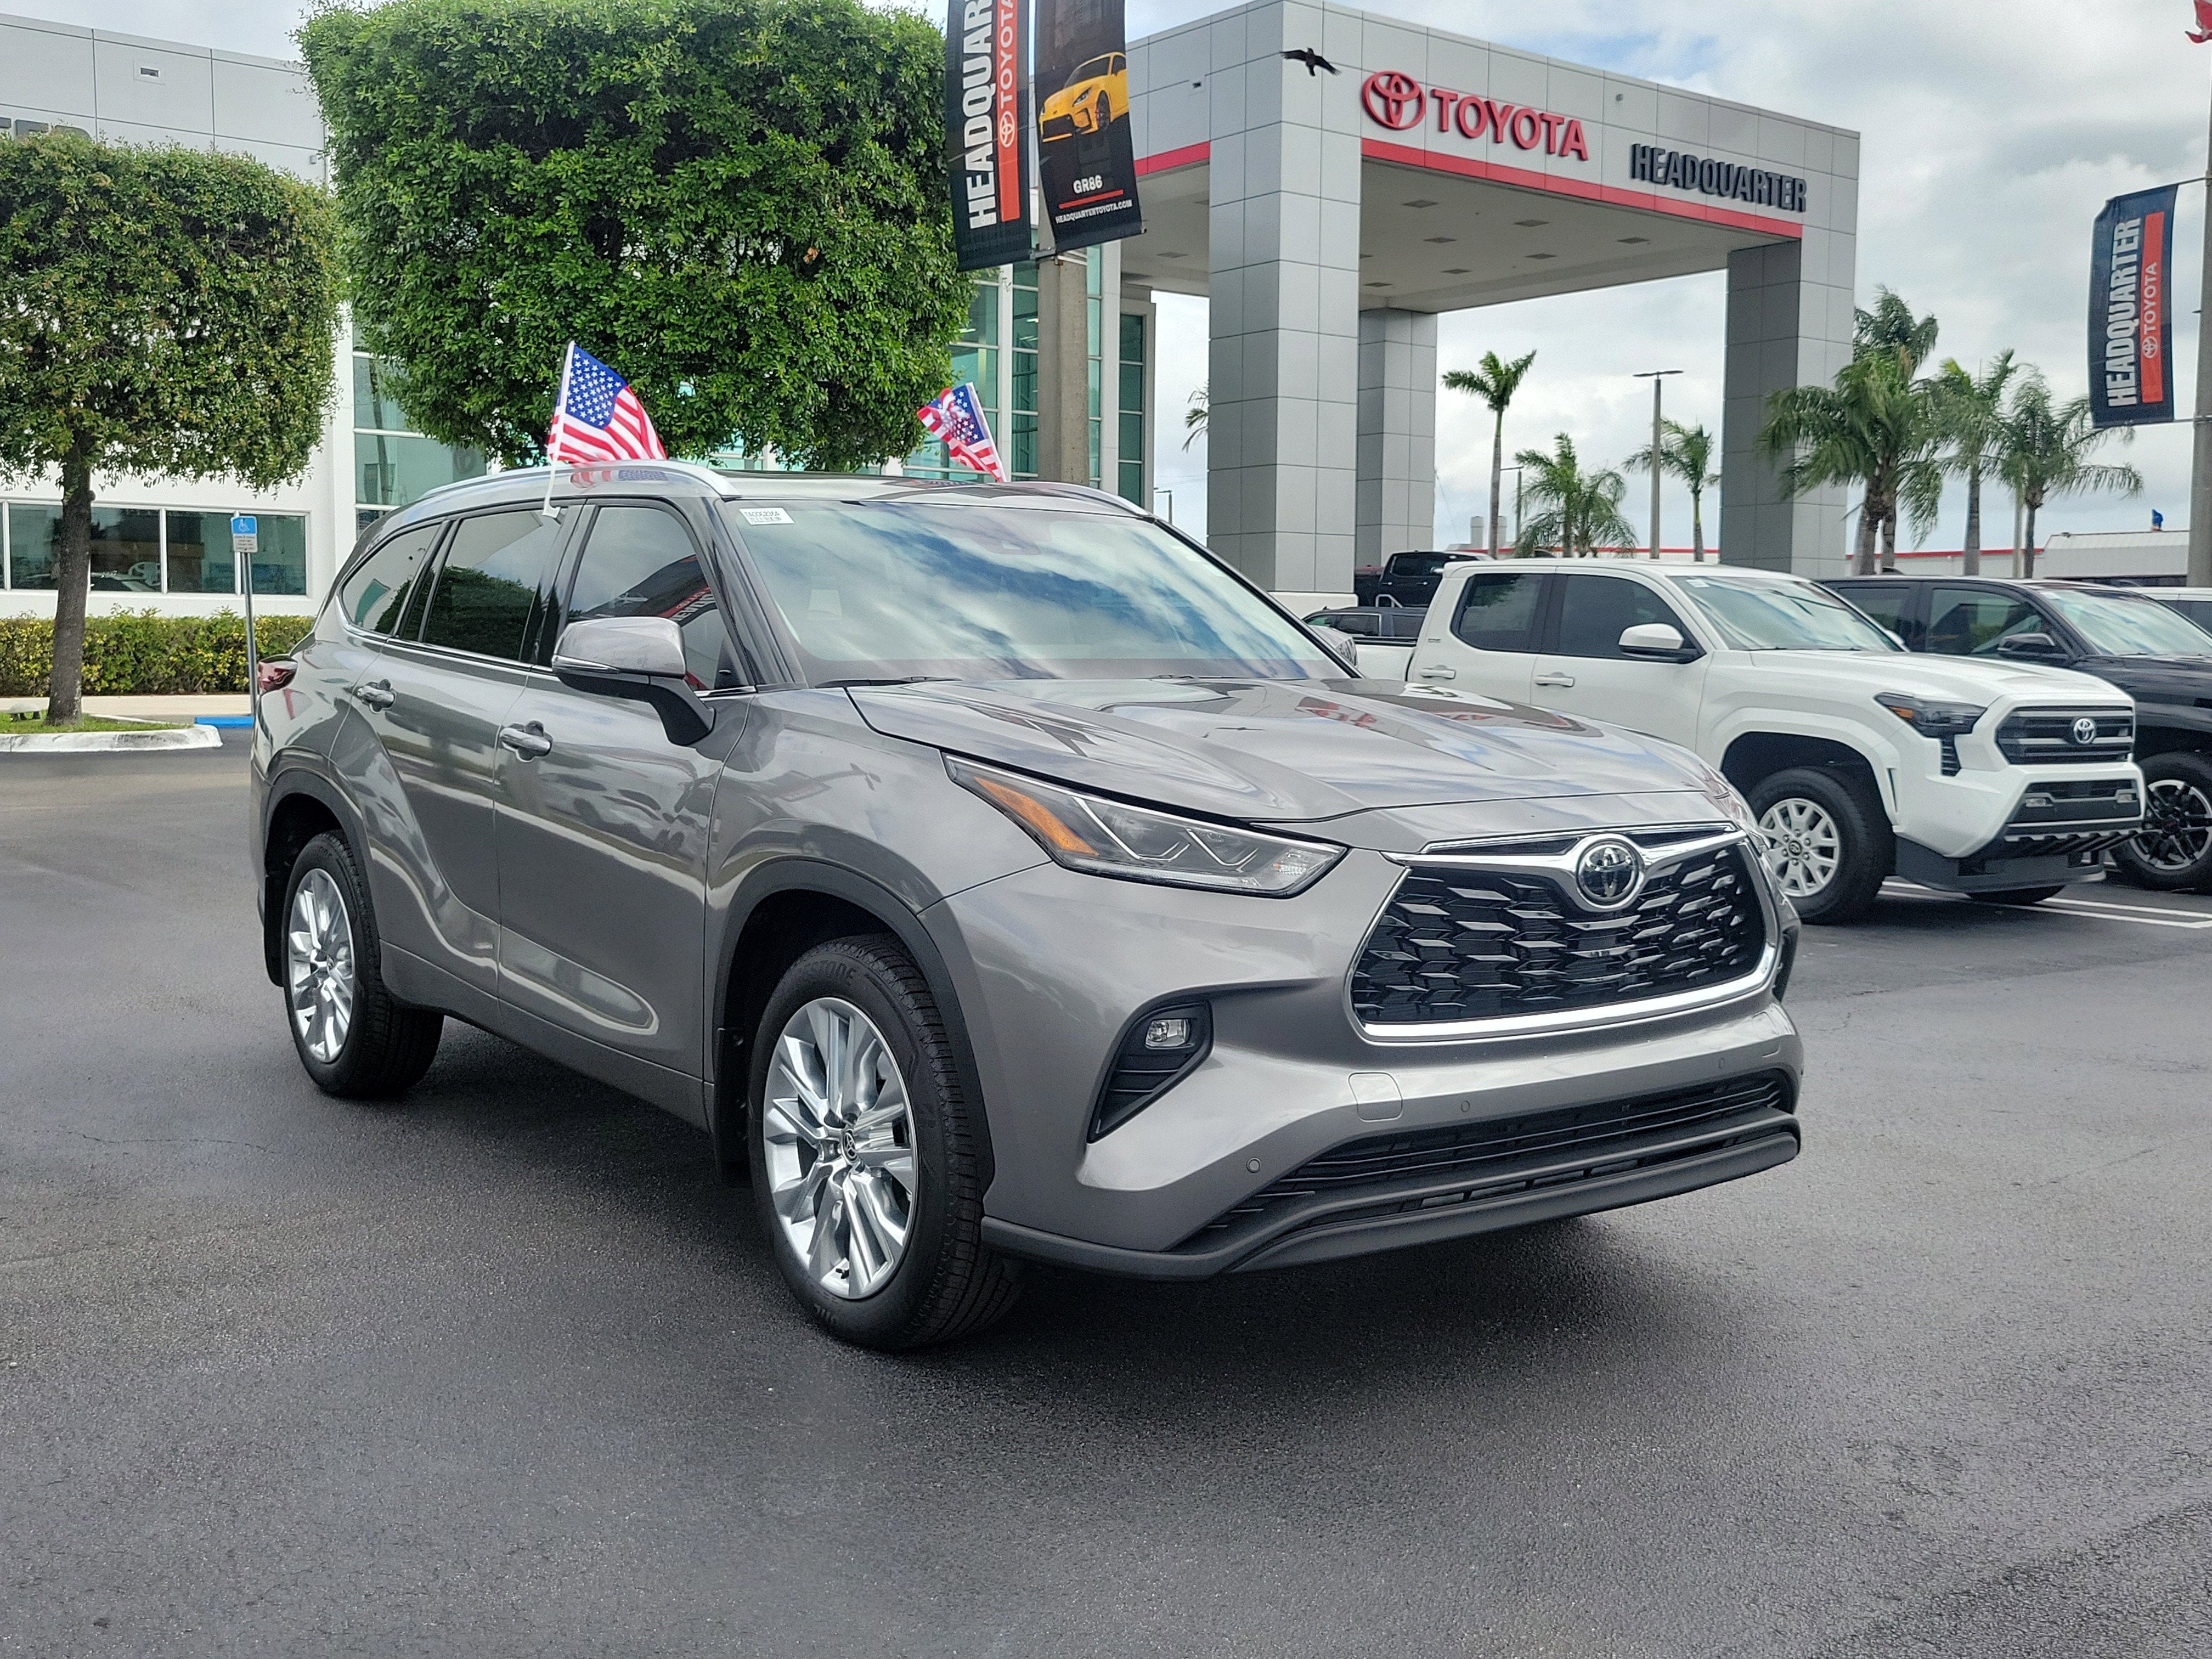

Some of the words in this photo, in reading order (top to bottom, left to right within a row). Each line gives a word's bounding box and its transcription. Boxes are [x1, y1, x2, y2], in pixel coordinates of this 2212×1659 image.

[963, 0, 997, 229] HEADQUAR
[1431, 88, 1589, 161] TOYOTA
[1073, 174, 1103, 194] GR86
[1630, 143, 1807, 213] HEADQUARTER
[2106, 217, 2141, 407] HEADQUARTER
[2143, 261, 2157, 334] TOYOTA
